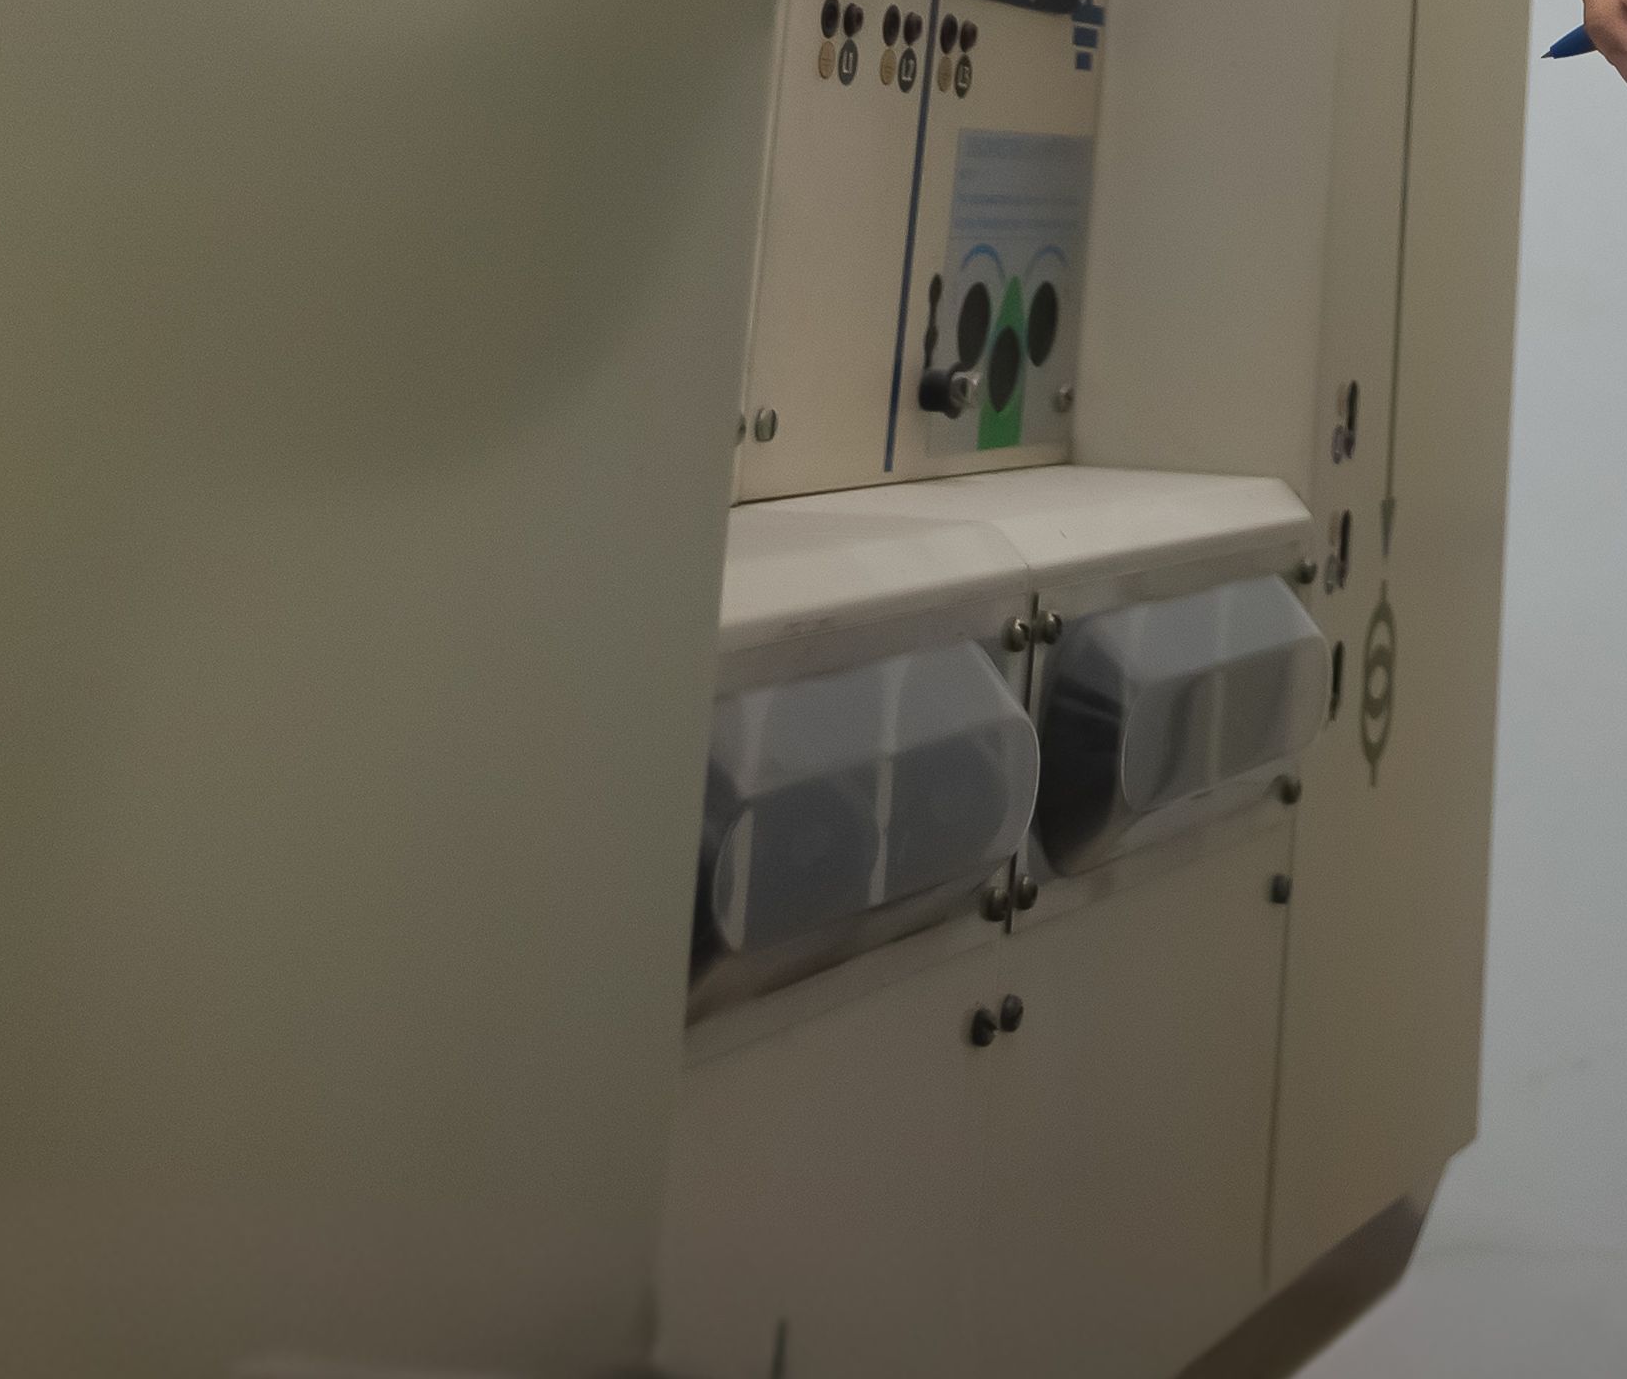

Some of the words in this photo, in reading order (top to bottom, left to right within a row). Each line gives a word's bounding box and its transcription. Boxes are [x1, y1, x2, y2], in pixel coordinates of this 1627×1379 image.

[843, 50, 854, 74] L1
[901, 57, 915, 81] L2
[958, 65, 970, 88] L3
